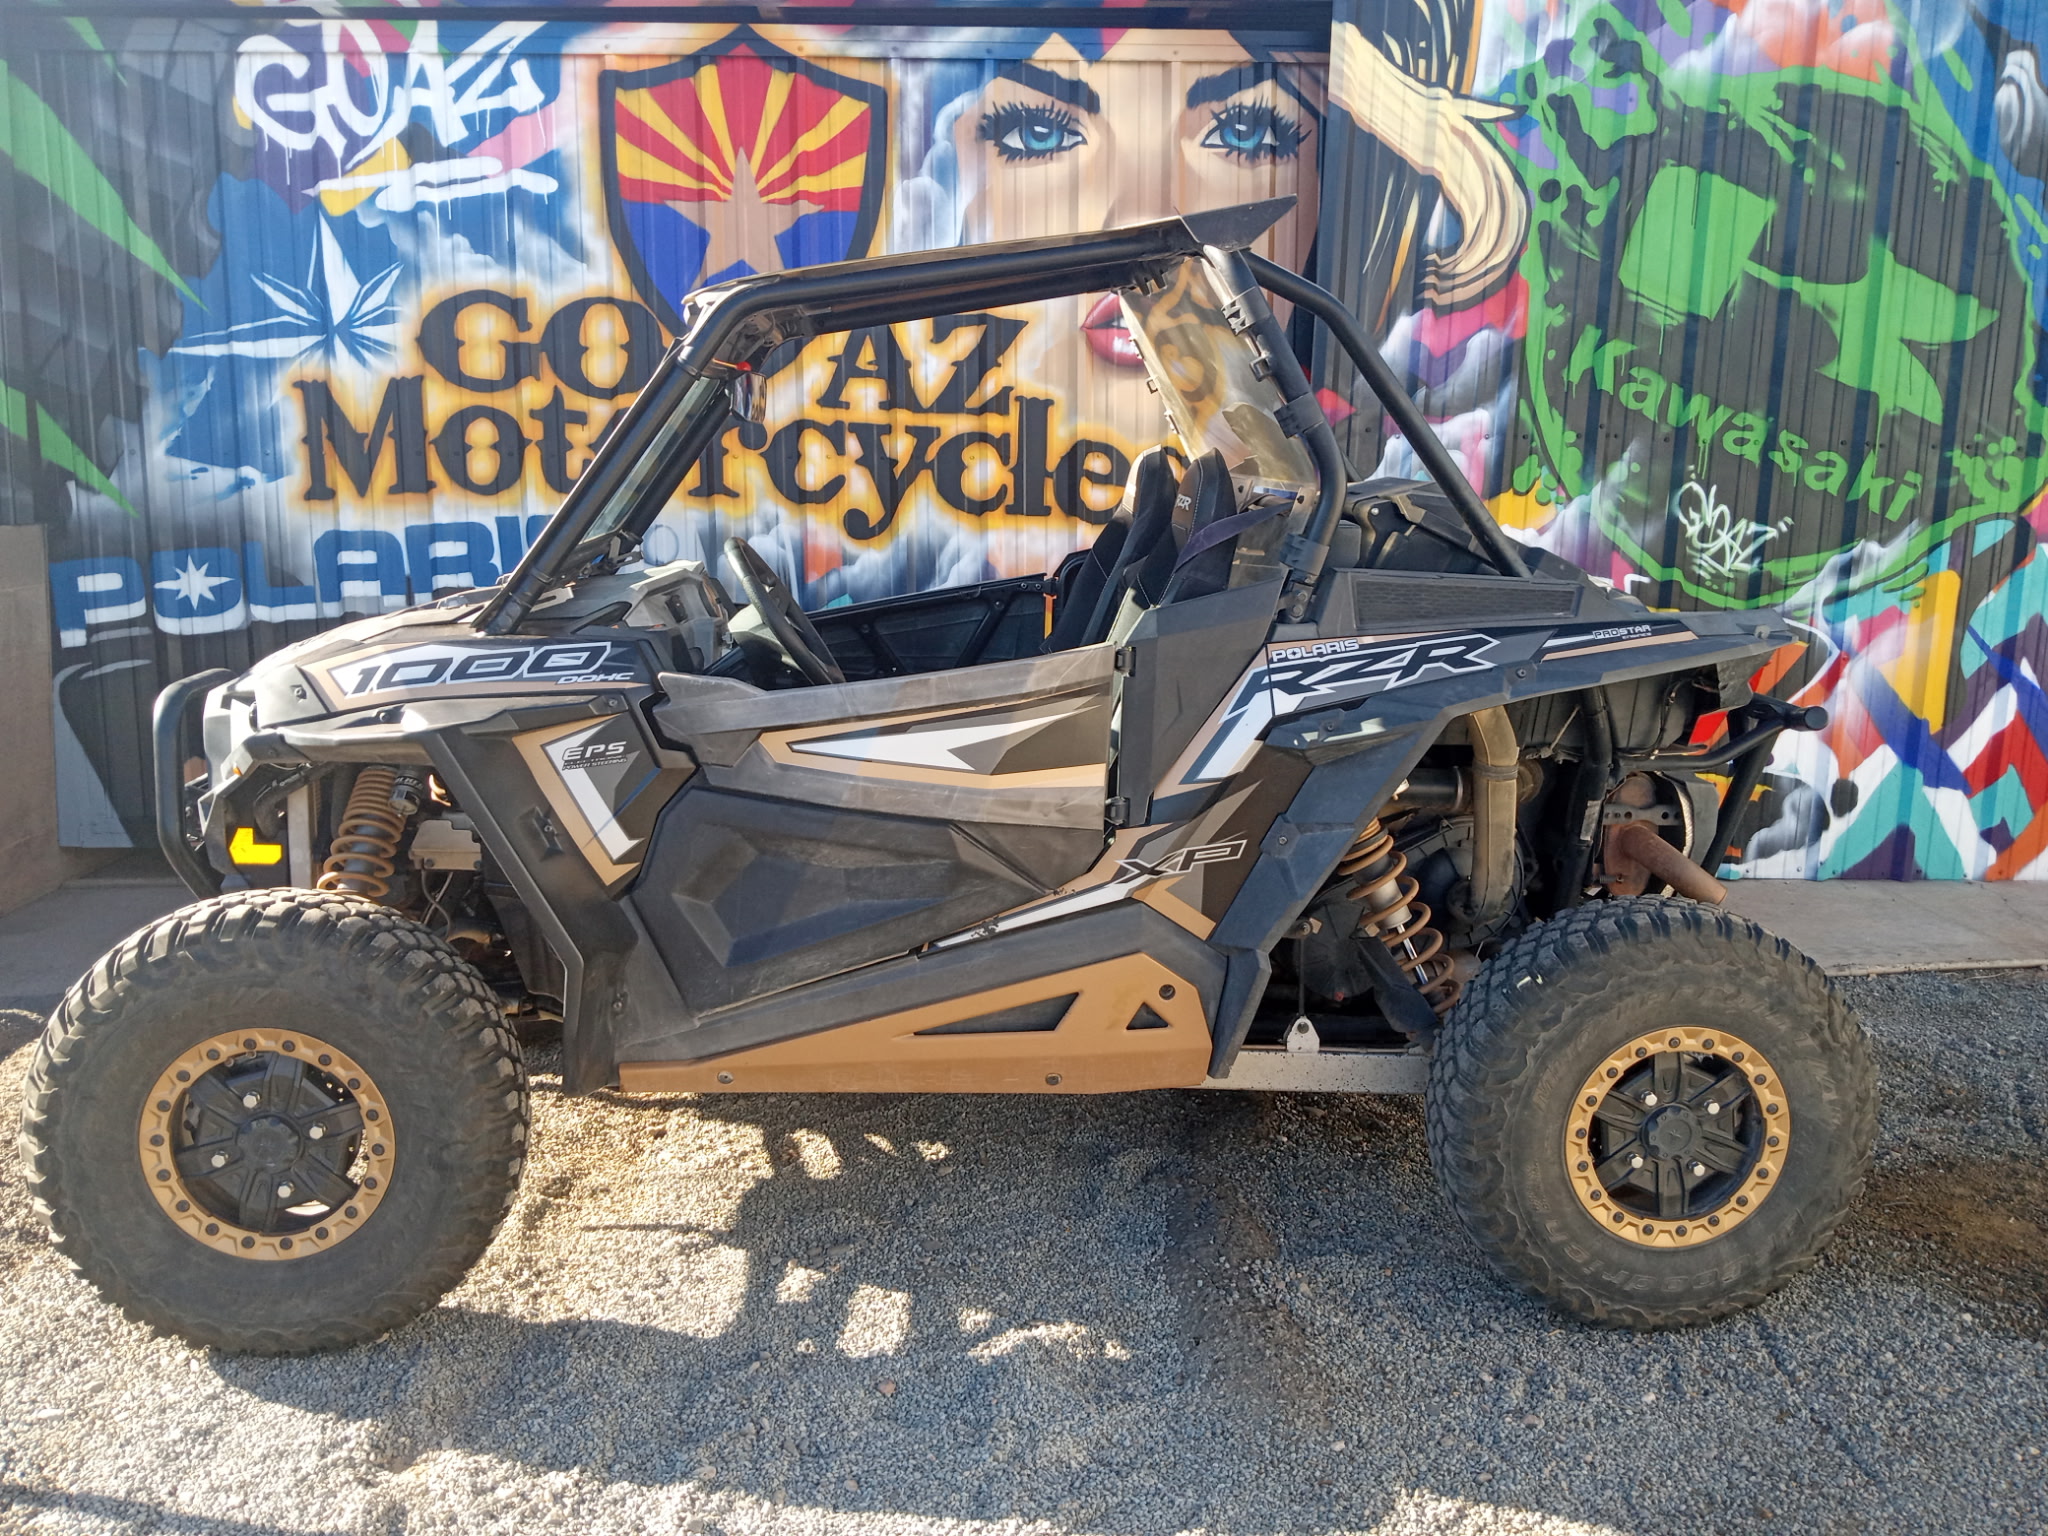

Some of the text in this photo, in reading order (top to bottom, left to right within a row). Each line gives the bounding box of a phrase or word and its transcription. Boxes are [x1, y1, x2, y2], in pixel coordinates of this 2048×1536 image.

[417, 288, 1029, 415] GO AZ
[1562, 323, 1923, 523] Kawasaki
[291, 374, 1192, 541] Motrcycle
[50, 514, 556, 647] POLARI
[1271, 638, 1361, 663] POLARIS
[1593, 624, 1652, 639] PROSTAR
[346, 642, 611, 698] 1000
[556, 672, 634, 685] DOHC
[1219, 633, 1501, 723] RZR
[562, 741, 627, 761] EPS
[1114, 839, 1248, 884] XP
